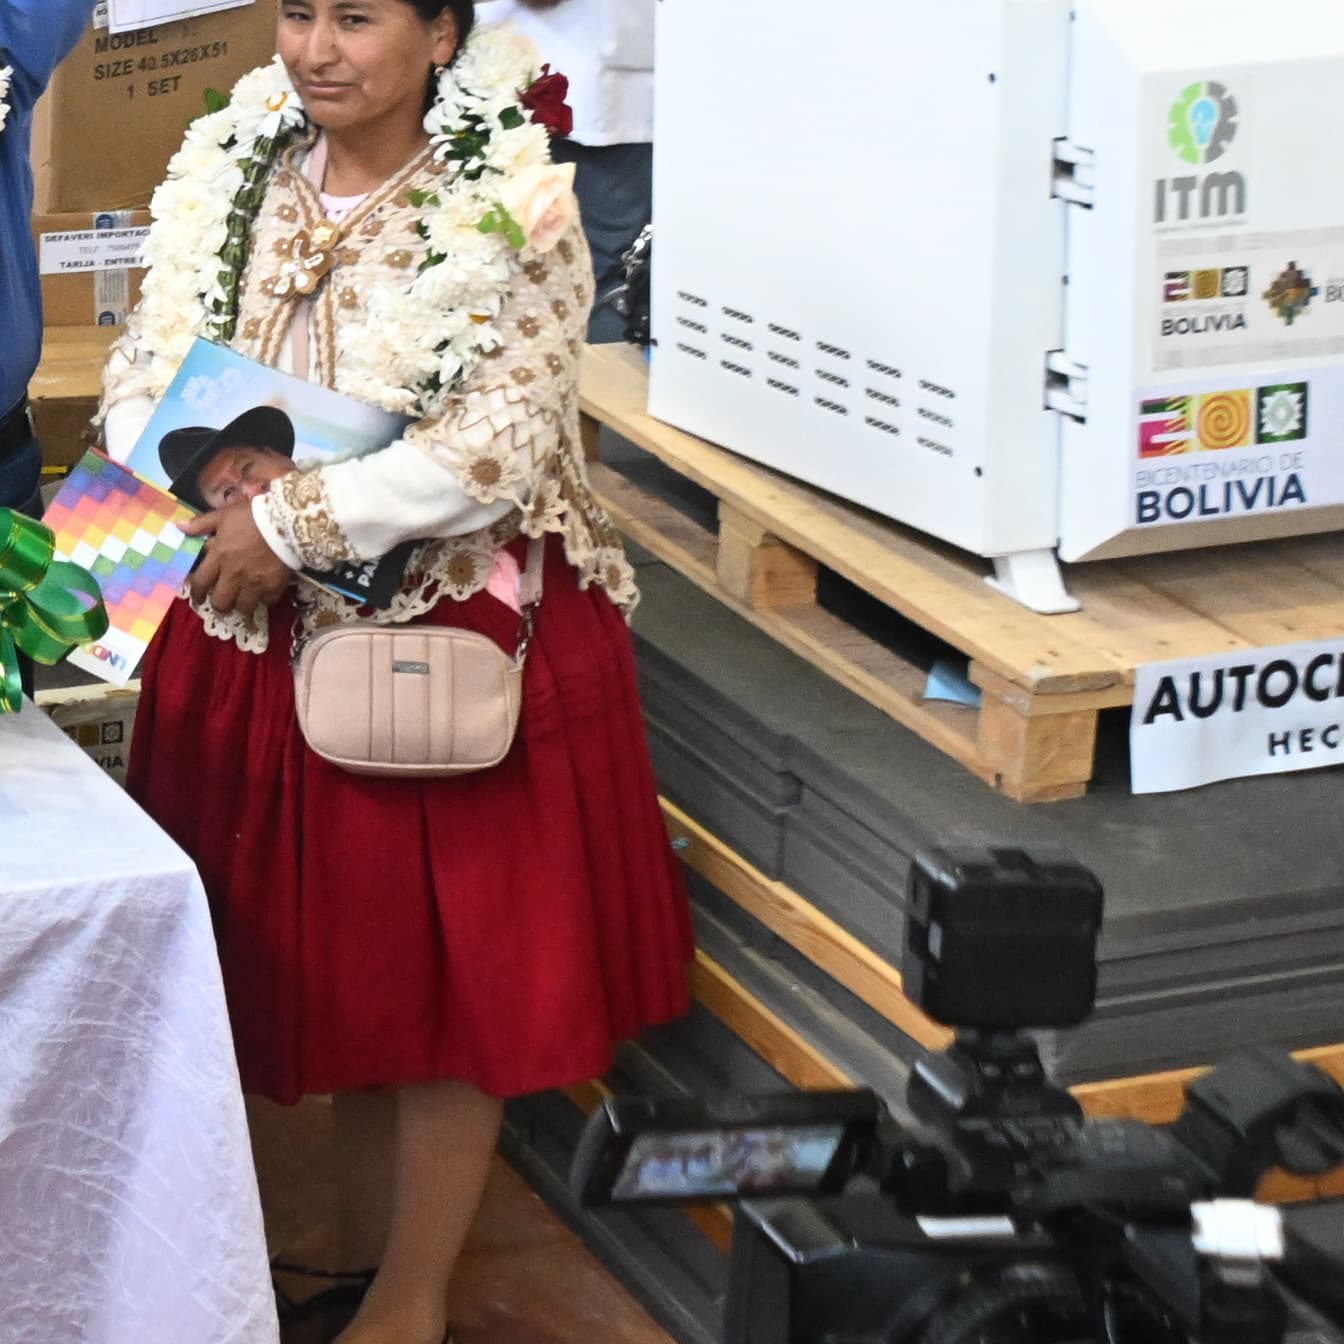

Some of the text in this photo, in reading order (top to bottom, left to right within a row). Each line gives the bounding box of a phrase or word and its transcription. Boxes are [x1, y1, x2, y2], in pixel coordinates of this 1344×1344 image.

[94, 30, 159, 54] MODEL
[94, 58, 134, 81] SIZE
[126, 75, 182, 99] 1 SET
[1154, 170, 1247, 223] ITM
[60, 261, 95, 269] TARIJA
[104, 257, 136, 266] ENTRE
[1161, 312, 1248, 337] BOLIVIA
[1136, 452, 1304, 488] BICENTENARIO DE
[1136, 472, 1307, 524] BOLIVIA
